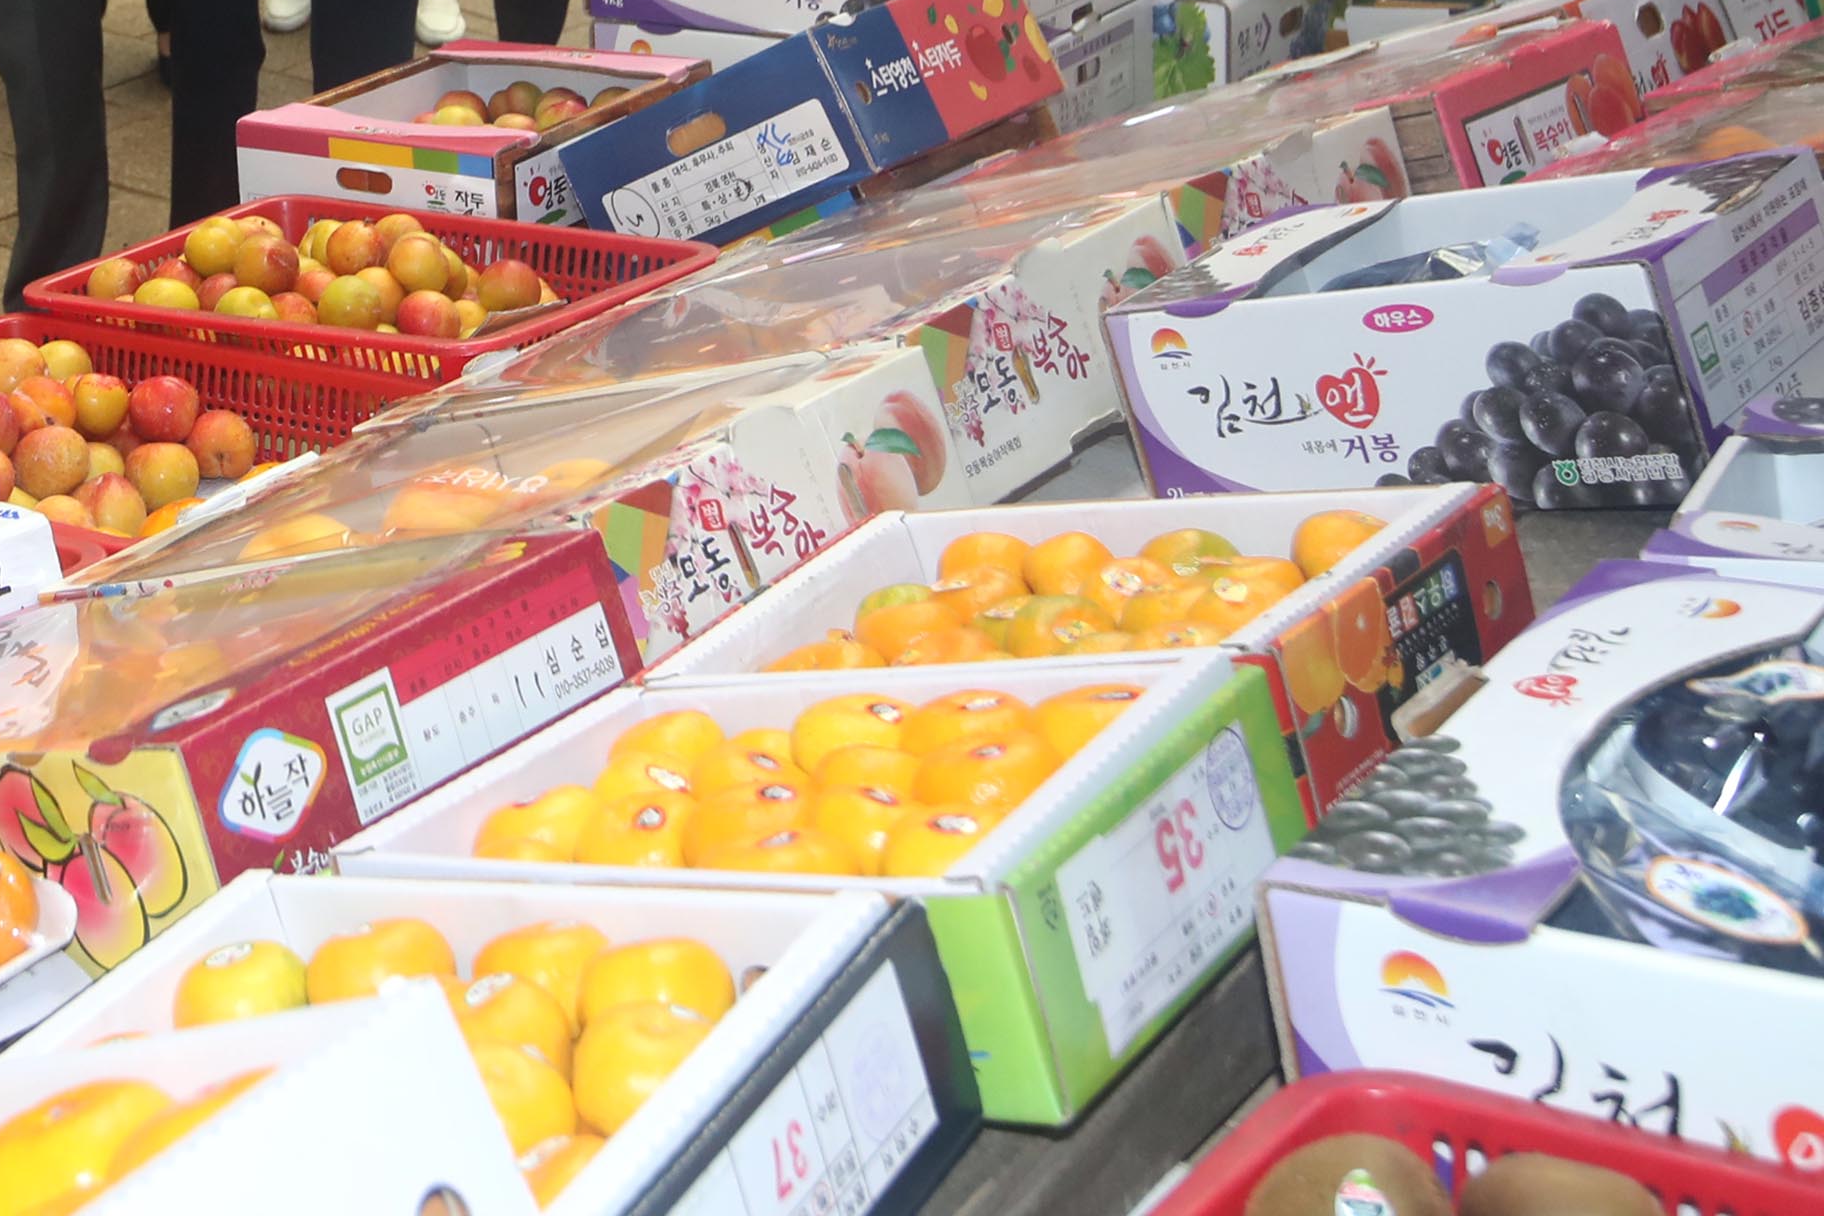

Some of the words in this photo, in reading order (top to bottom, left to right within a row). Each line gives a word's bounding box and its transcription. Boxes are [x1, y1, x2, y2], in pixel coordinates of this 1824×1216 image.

[870, 55, 921, 97] 스타영천
[917, 39, 963, 78] 스타자두
[1486, 137, 1522, 170] 영동
[1532, 117, 1574, 153] 복숭아
[453, 189, 485, 210] 자두
[528, 174, 568, 211] 영동
[1032, 311, 1090, 380] 복숭아
[1372, 309, 1425, 328] 하우스
[975, 355, 1017, 415] 모동
[1186, 373, 1282, 439] 김천
[1340, 433, 1401, 465] 거봉
[750, 483, 827, 561] 복숭아
[679, 536, 731, 603] 모동
[545, 619, 610, 676] 심순섭
[351, 706, 384, 737] GAP
[237, 752, 311, 822] 하늘작
[1154, 797, 1205, 895] 35
[771, 1119, 808, 1202] 37
